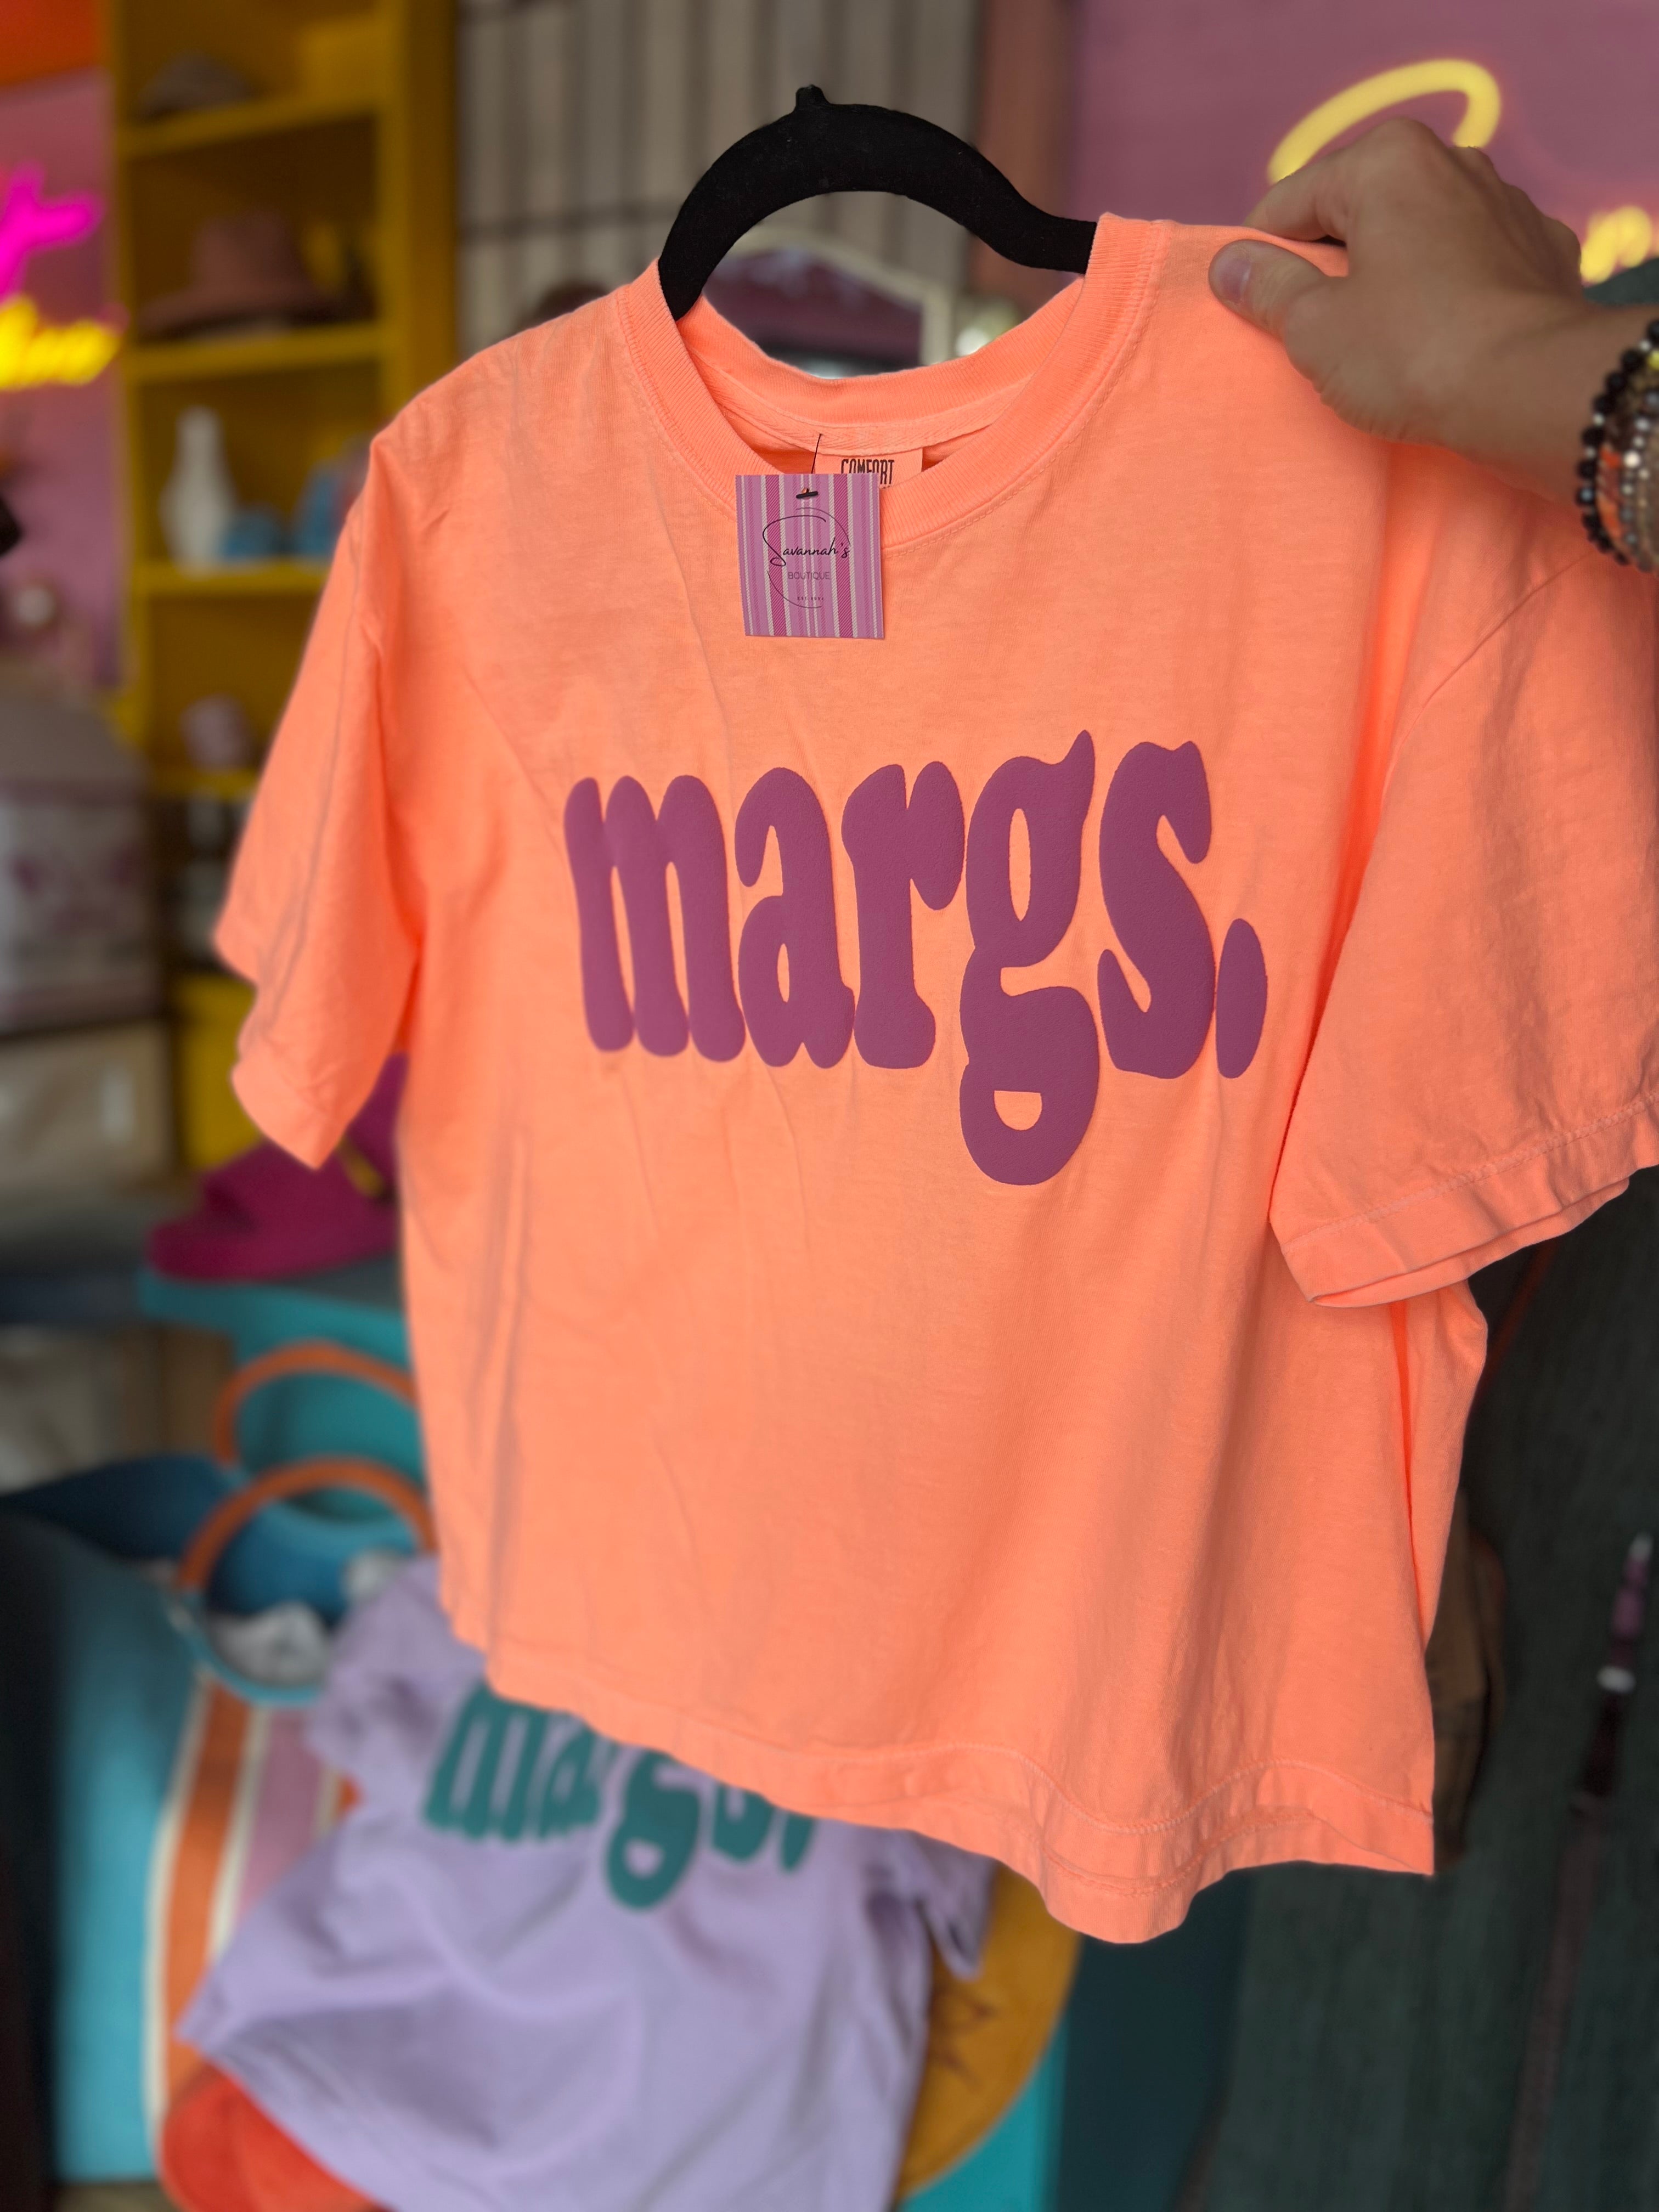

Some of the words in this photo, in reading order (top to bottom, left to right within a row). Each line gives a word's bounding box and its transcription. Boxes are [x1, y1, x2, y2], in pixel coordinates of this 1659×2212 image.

[762, 515, 850, 567] Savannah's
[788, 572, 830, 580] BOUTIQUE
[563, 729, 1268, 1186] margs.
